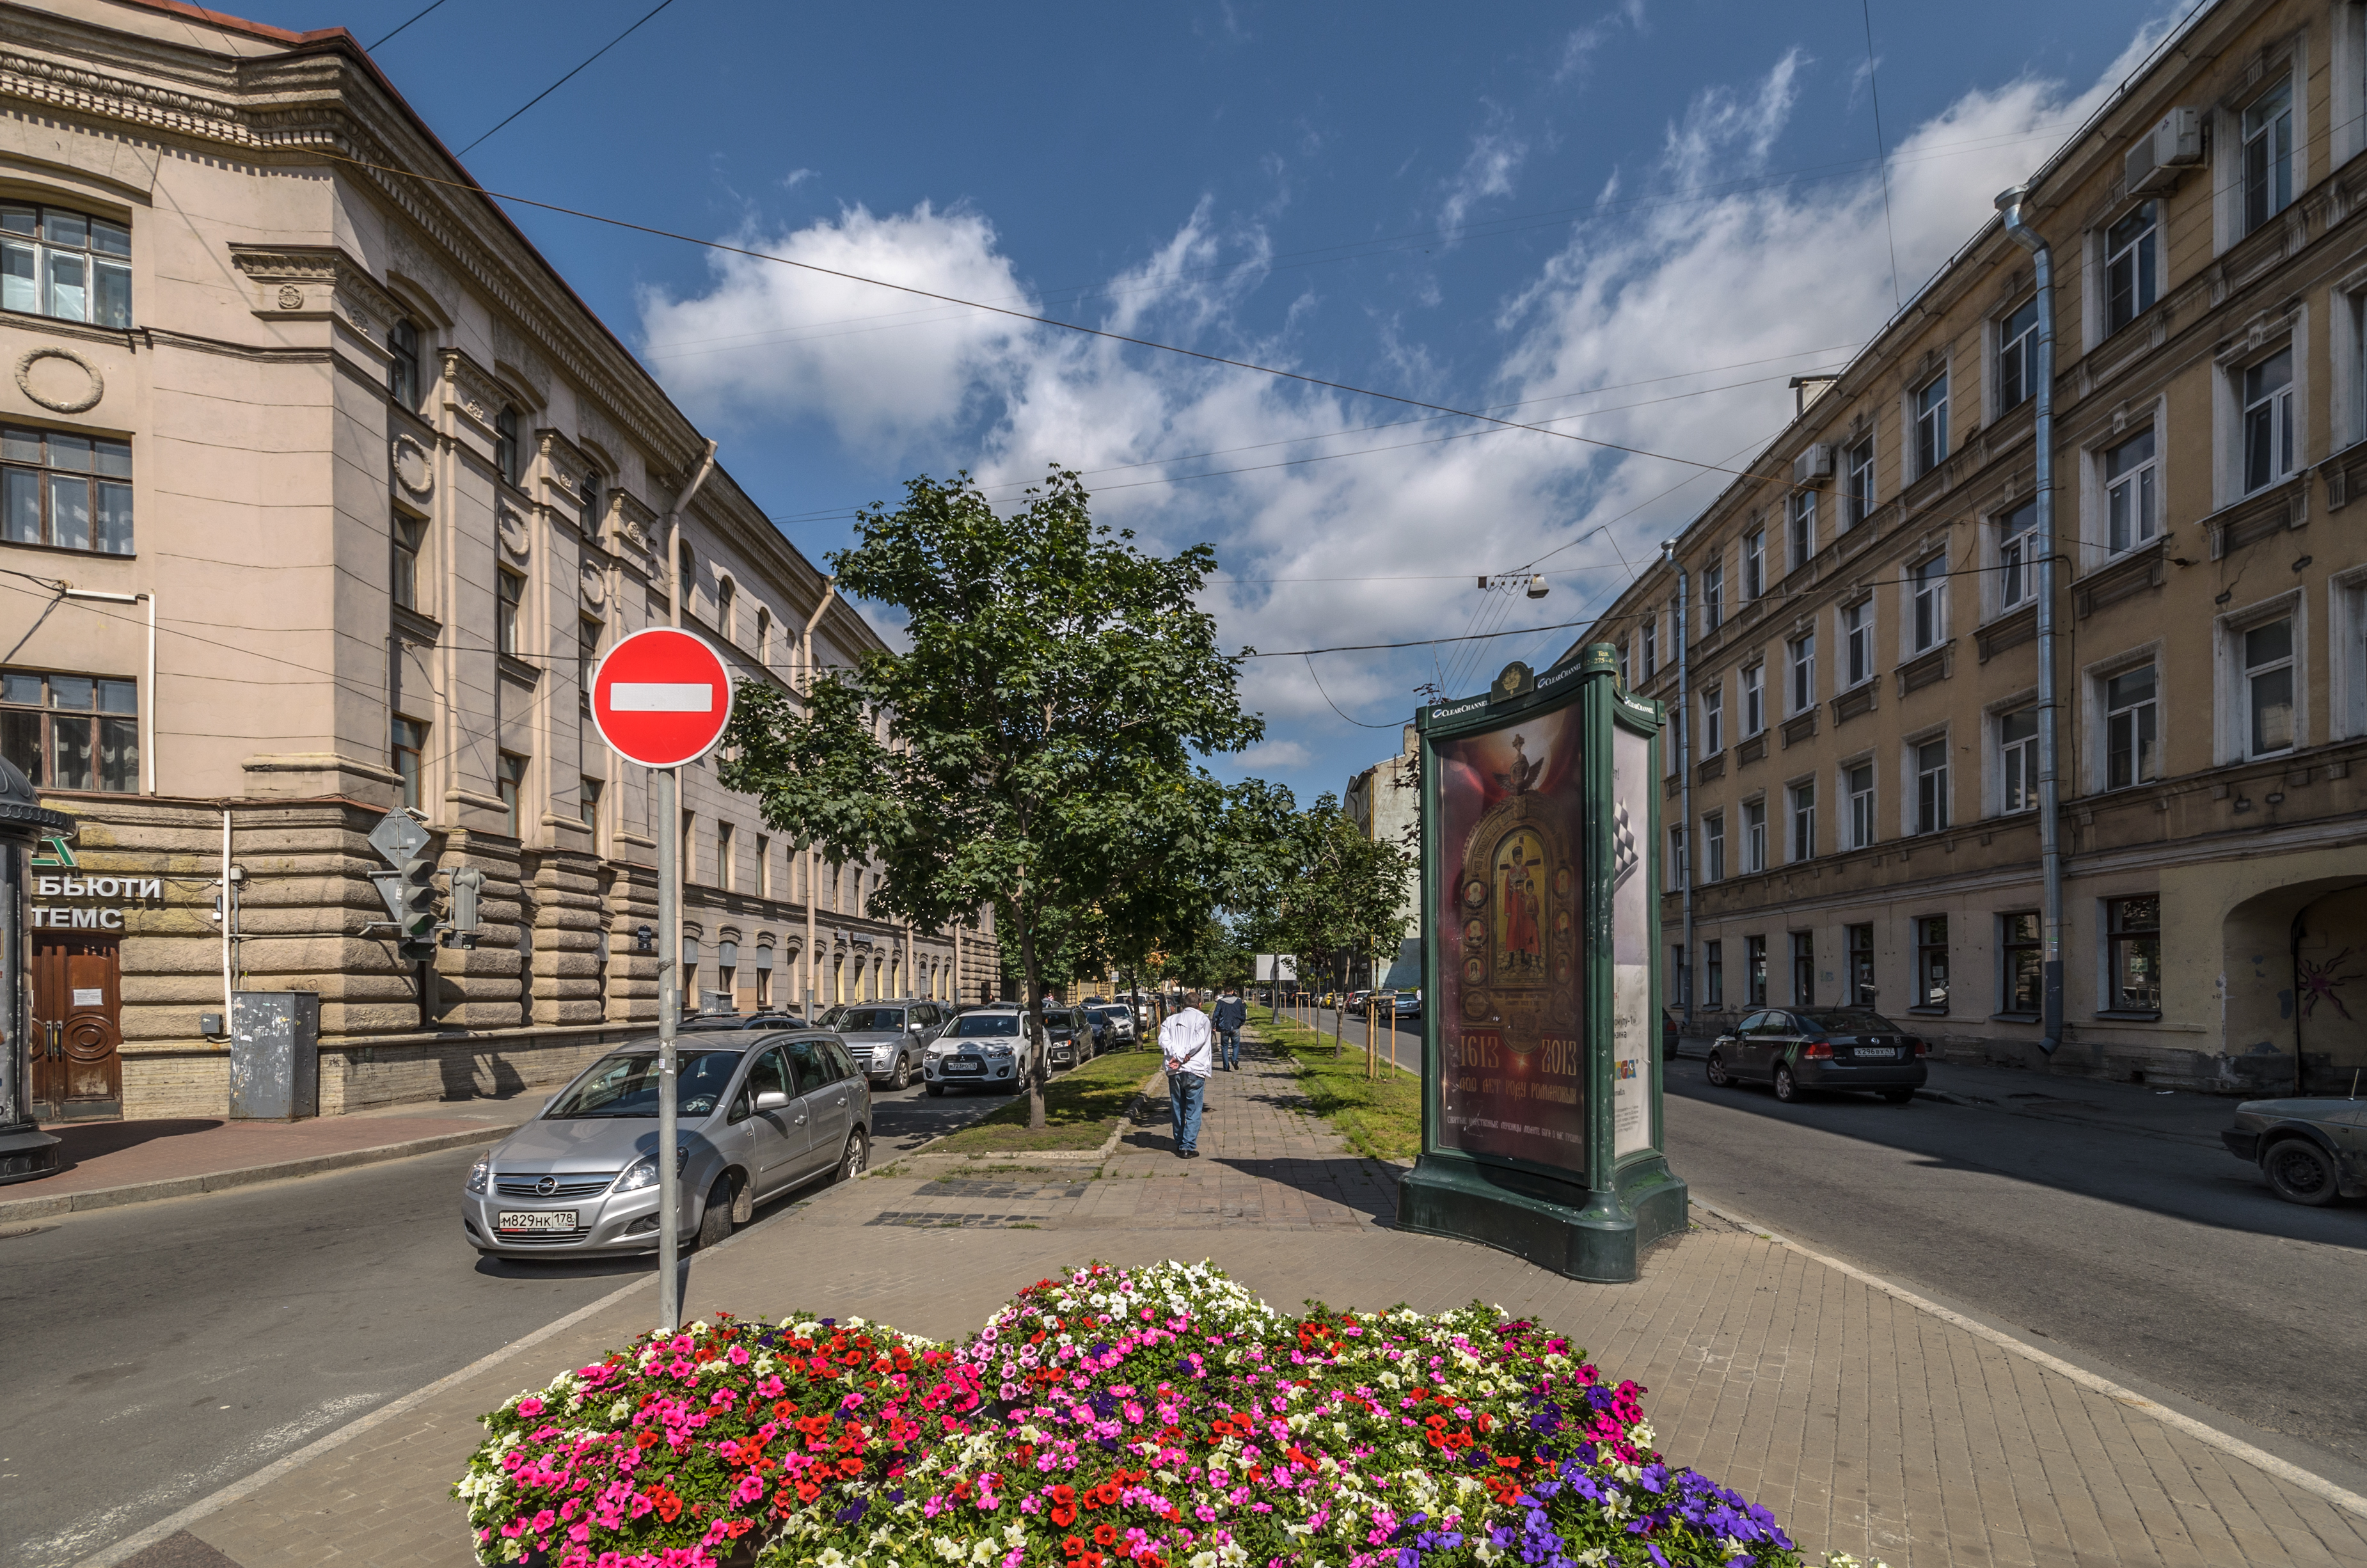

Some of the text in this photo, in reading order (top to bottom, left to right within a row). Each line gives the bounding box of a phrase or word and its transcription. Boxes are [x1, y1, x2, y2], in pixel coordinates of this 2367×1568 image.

[39, 876, 161, 898] БЬЮТИ
[1460, 1035, 1577, 1076] 1613 2013
[1459, 1077, 1577, 1105] 400 ЛЕТ РОДУ РОМАНОВЫХ
[1447, 1116, 1468, 1125] СВЯТЫЕ
[1552, 1130, 1555, 1139] О
[503, 1214, 573, 1226] М829НК 178
